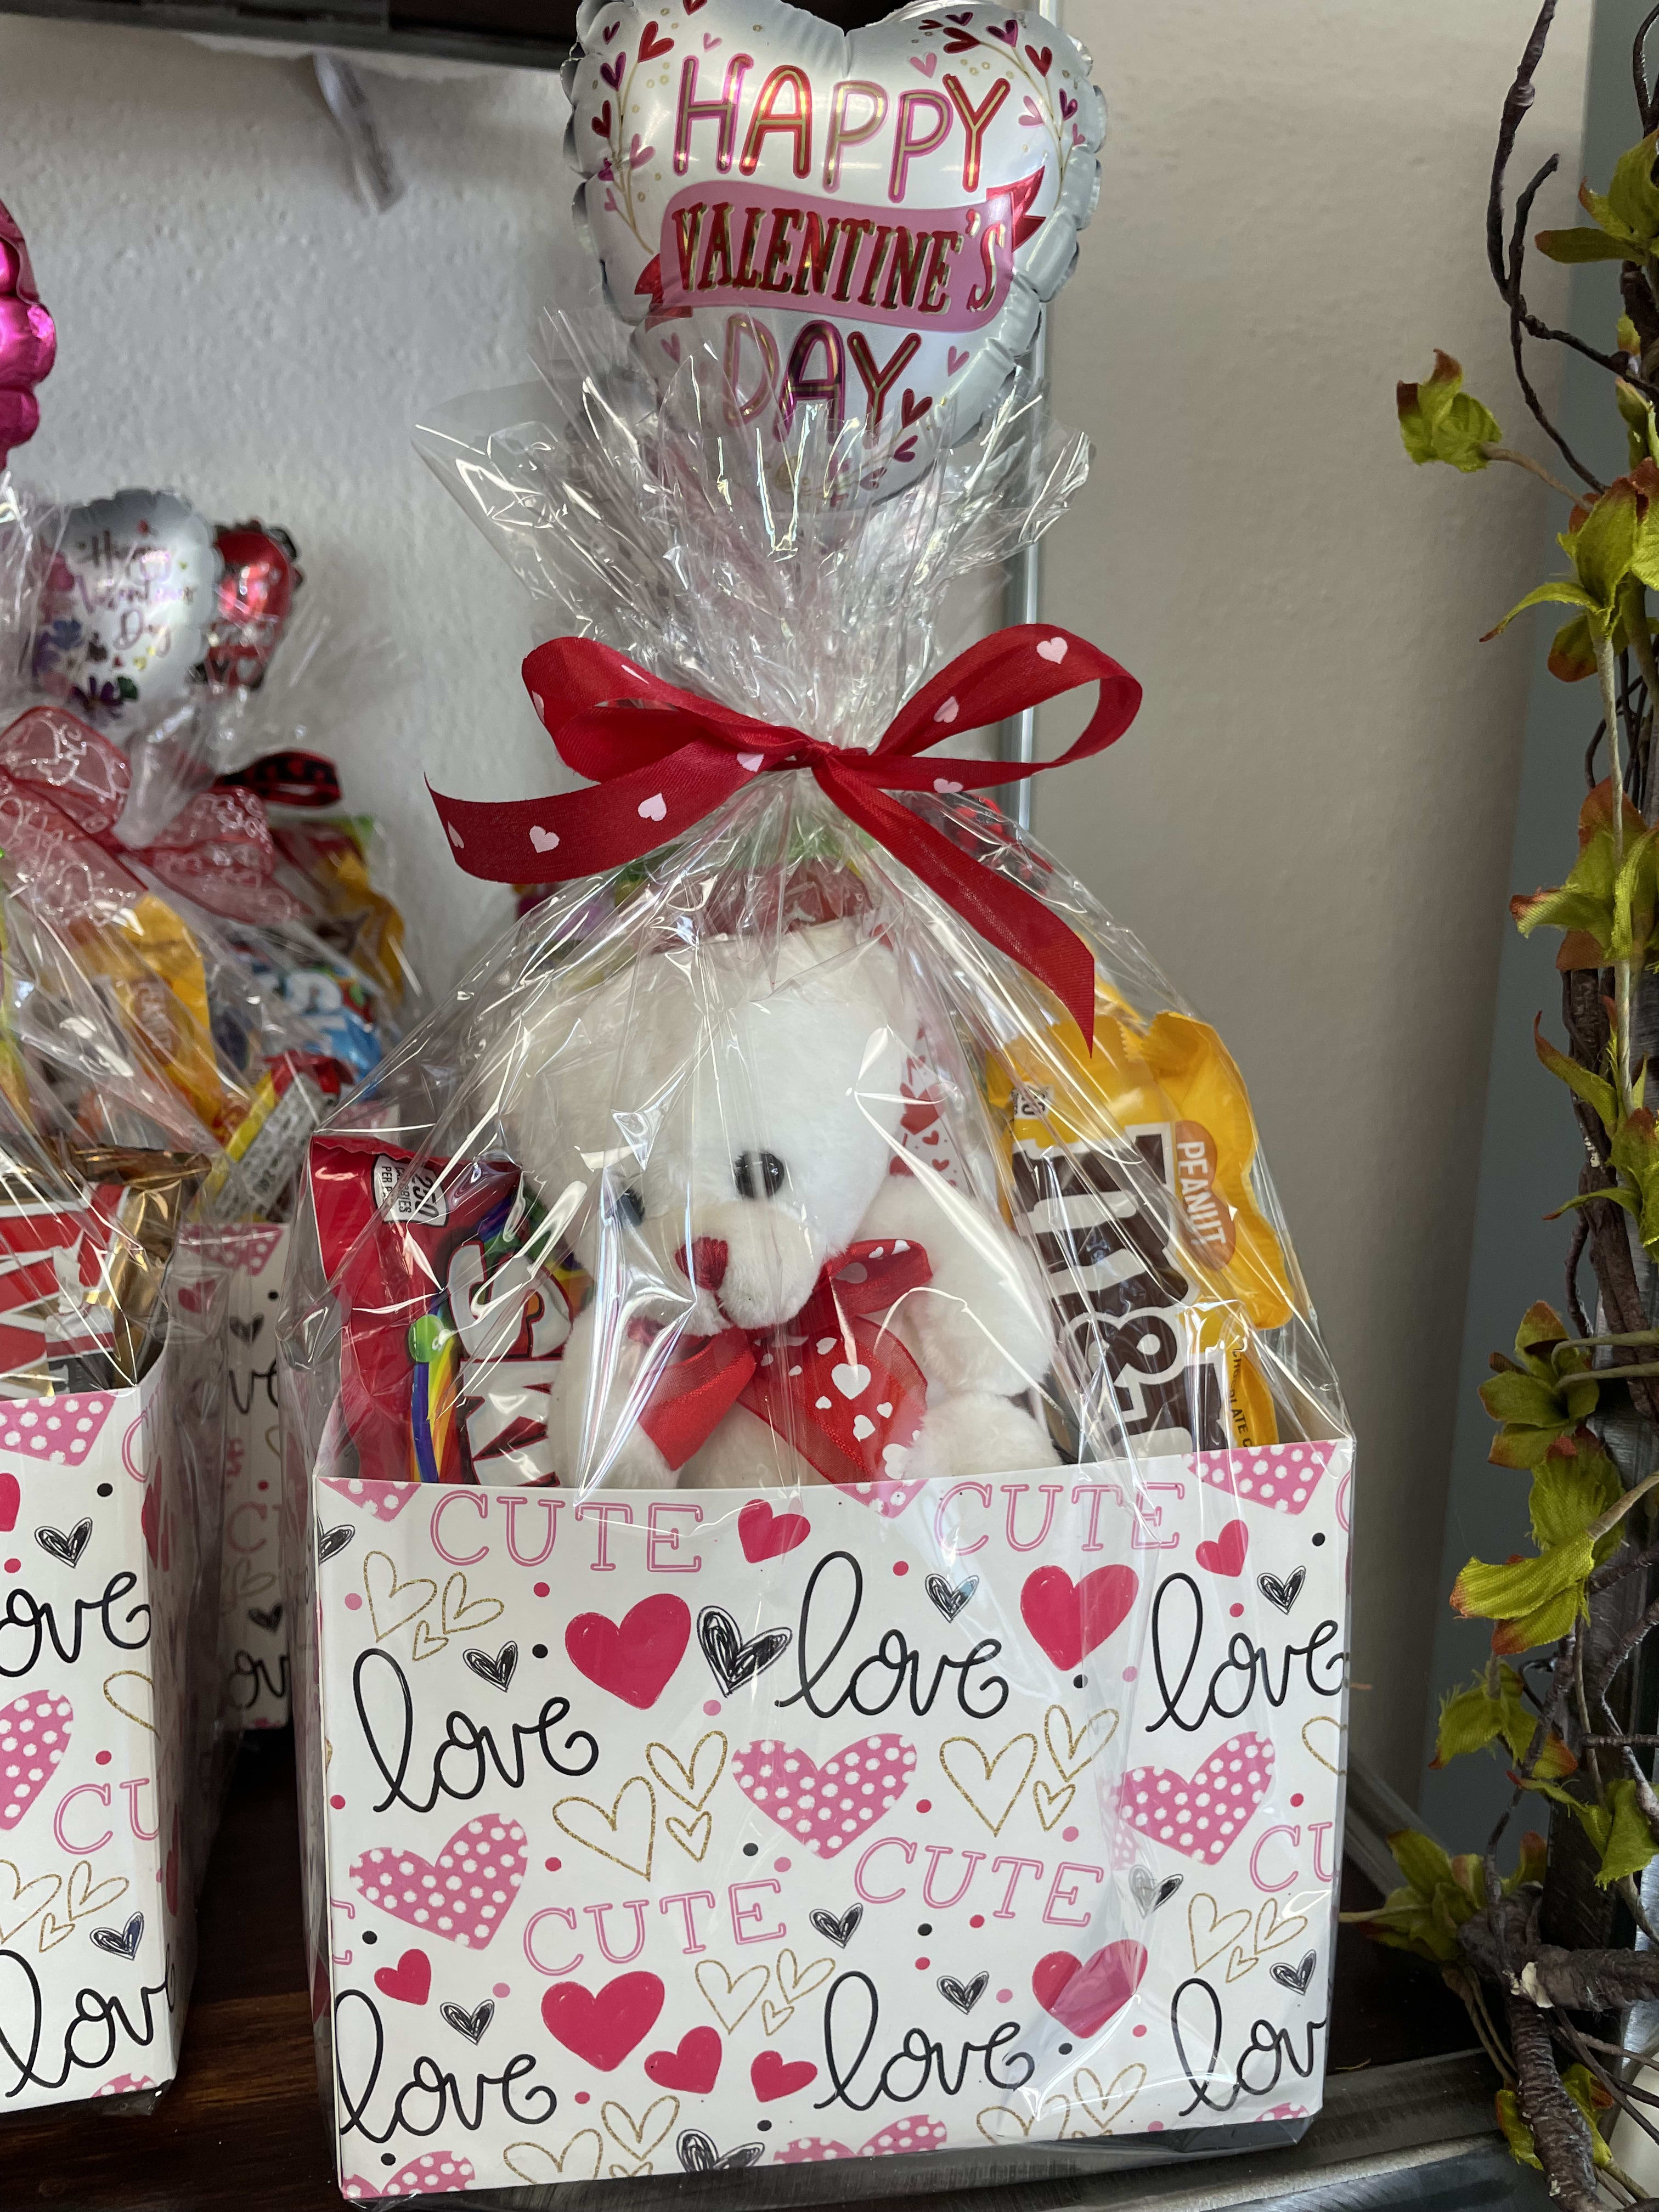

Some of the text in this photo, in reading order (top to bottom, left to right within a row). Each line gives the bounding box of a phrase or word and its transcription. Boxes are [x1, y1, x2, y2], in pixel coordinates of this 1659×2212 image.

[674, 53, 1011, 203] HAPPY
[672, 202, 1008, 313] VALENTINE'S
[723, 313, 922, 451] DAY
[382, 1166, 392, 1182] PER
[396, 1167, 411, 1213] CAORIES
[412, 1174, 439, 1218] 250
[1176, 1140, 1226, 1246] PEANUT
[430, 1489, 703, 1572] CUTE
[933, 1481, 1184, 1555] CUTE
[0, 1571, 151, 1678] ove
[774, 1550, 1009, 1719] love
[1146, 1572, 1350, 1733] love
[353, 1648, 599, 1813] love
[523, 1878, 787, 1976] CUTE
[854, 1836, 1104, 1927] CUTE
[336, 1989, 557, 2143] love
[813, 1970, 1035, 2111] love
[1171, 1977, 1328, 2117] lov
